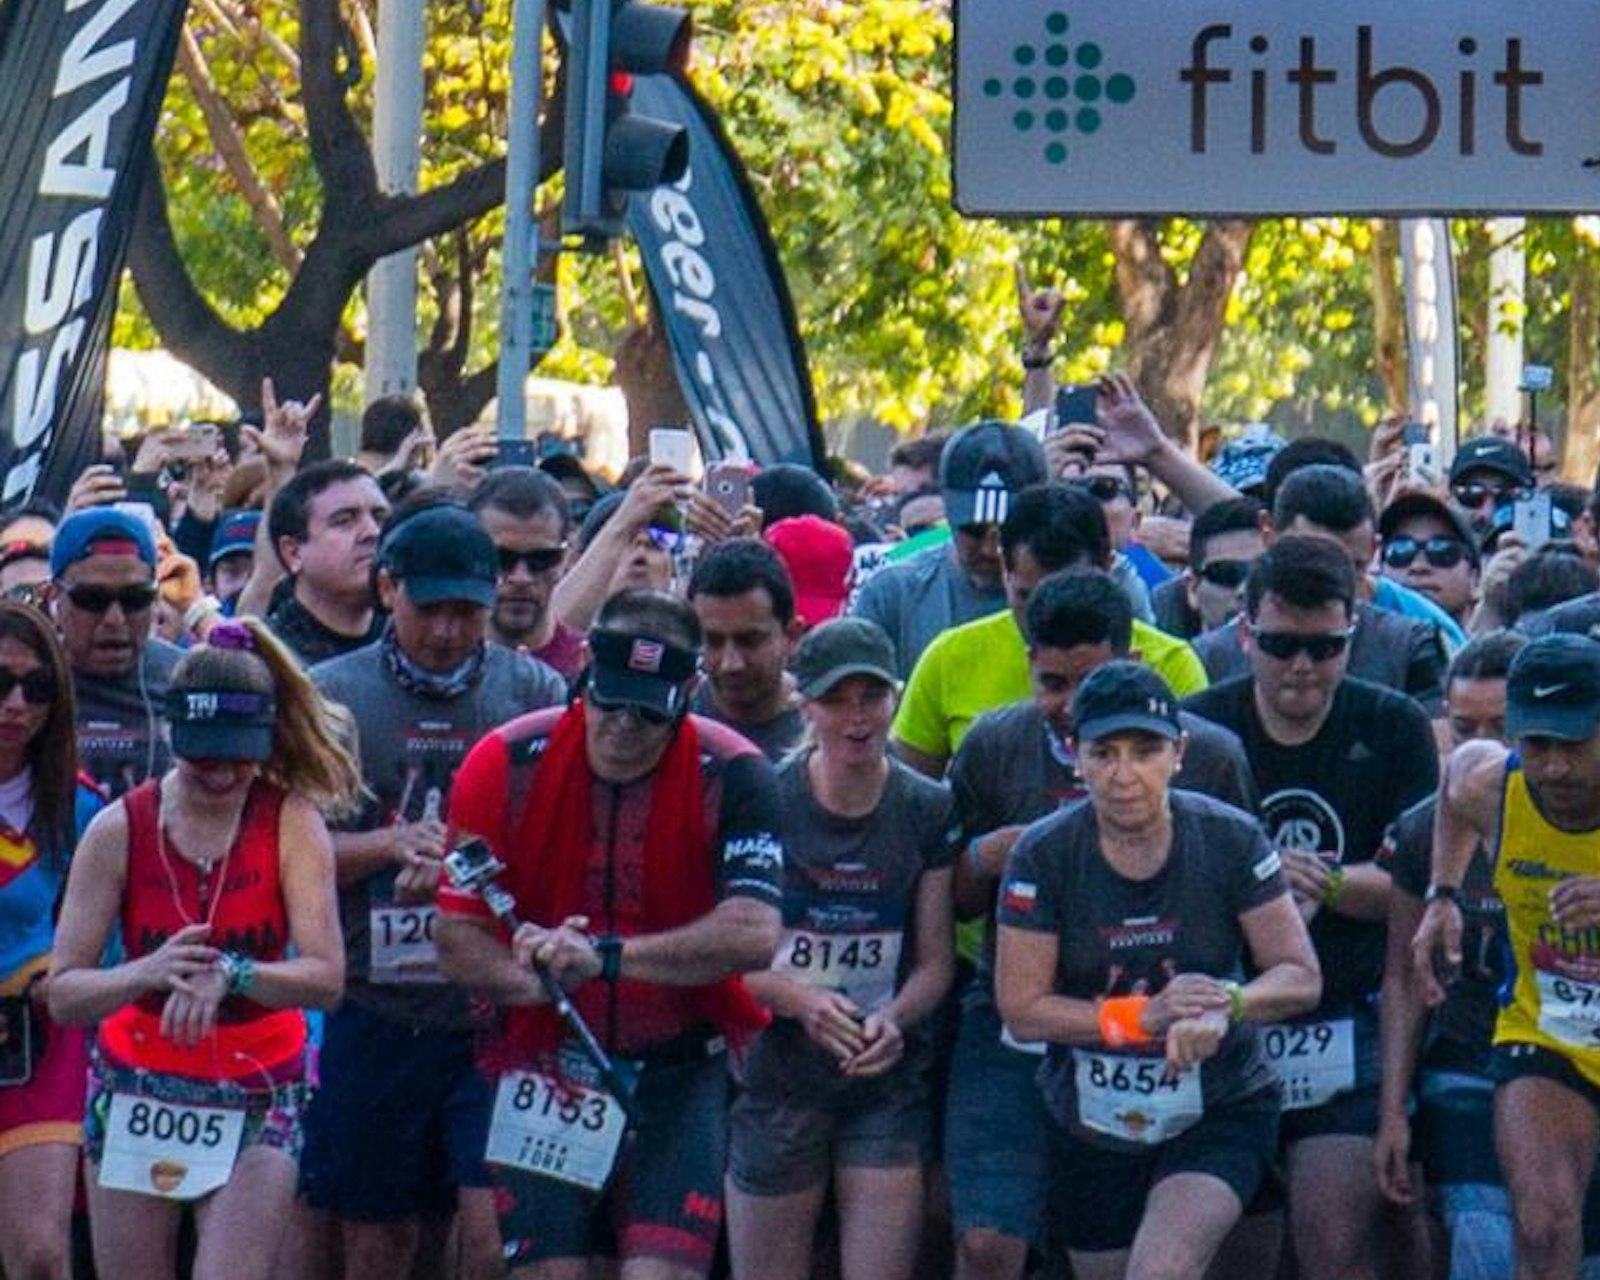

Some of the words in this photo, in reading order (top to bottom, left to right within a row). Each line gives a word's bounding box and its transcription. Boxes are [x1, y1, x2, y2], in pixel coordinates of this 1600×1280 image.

[1179, 24, 1543, 158] fitbit
[790, 936, 883, 972] 8143
[1265, 1024, 1334, 1058] 029
[1091, 1058, 1180, 1094] 8654
[128, 1102, 226, 1148] 8005
[513, 1078, 607, 1131] 8153
